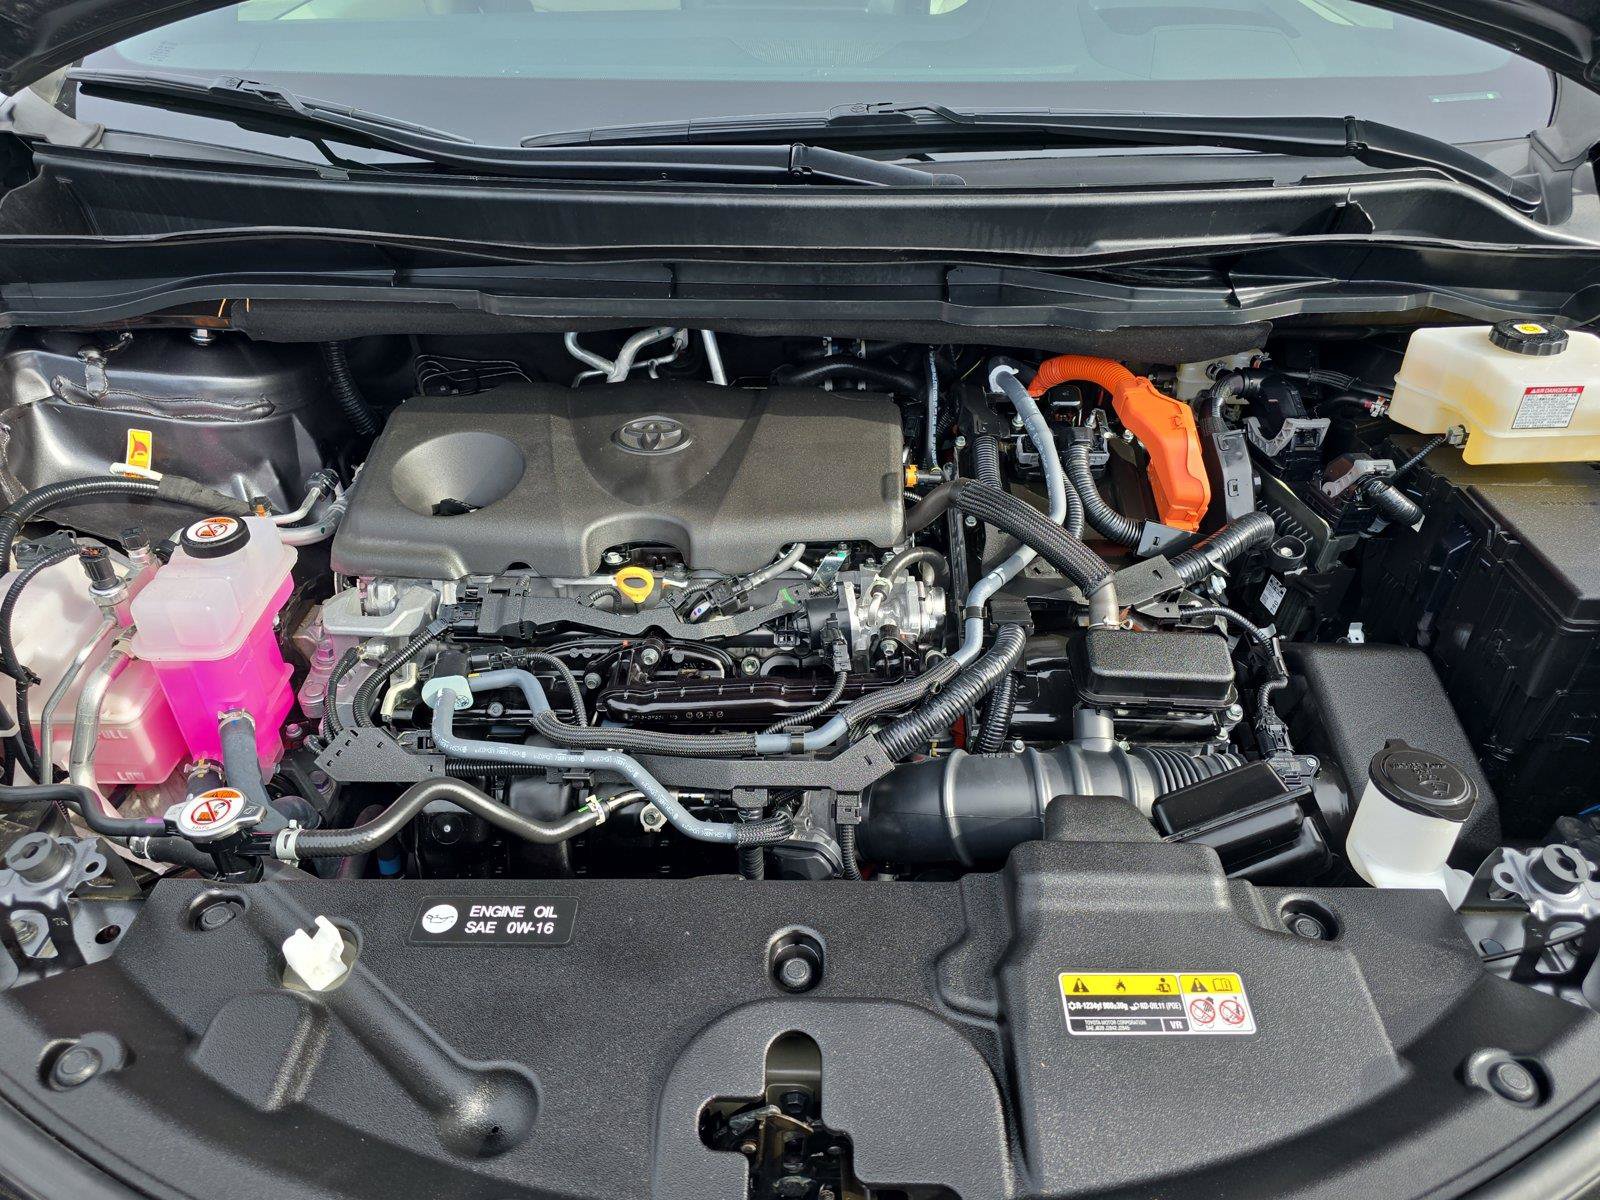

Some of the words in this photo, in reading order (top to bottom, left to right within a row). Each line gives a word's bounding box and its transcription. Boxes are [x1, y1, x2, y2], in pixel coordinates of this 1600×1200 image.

[469, 905, 526, 918] ENGINE
[533, 905, 558, 918] OIL
[464, 921, 498, 934] SAE
[506, 921, 555, 934] 0W-16
[1170, 1020, 1183, 1029] VR
